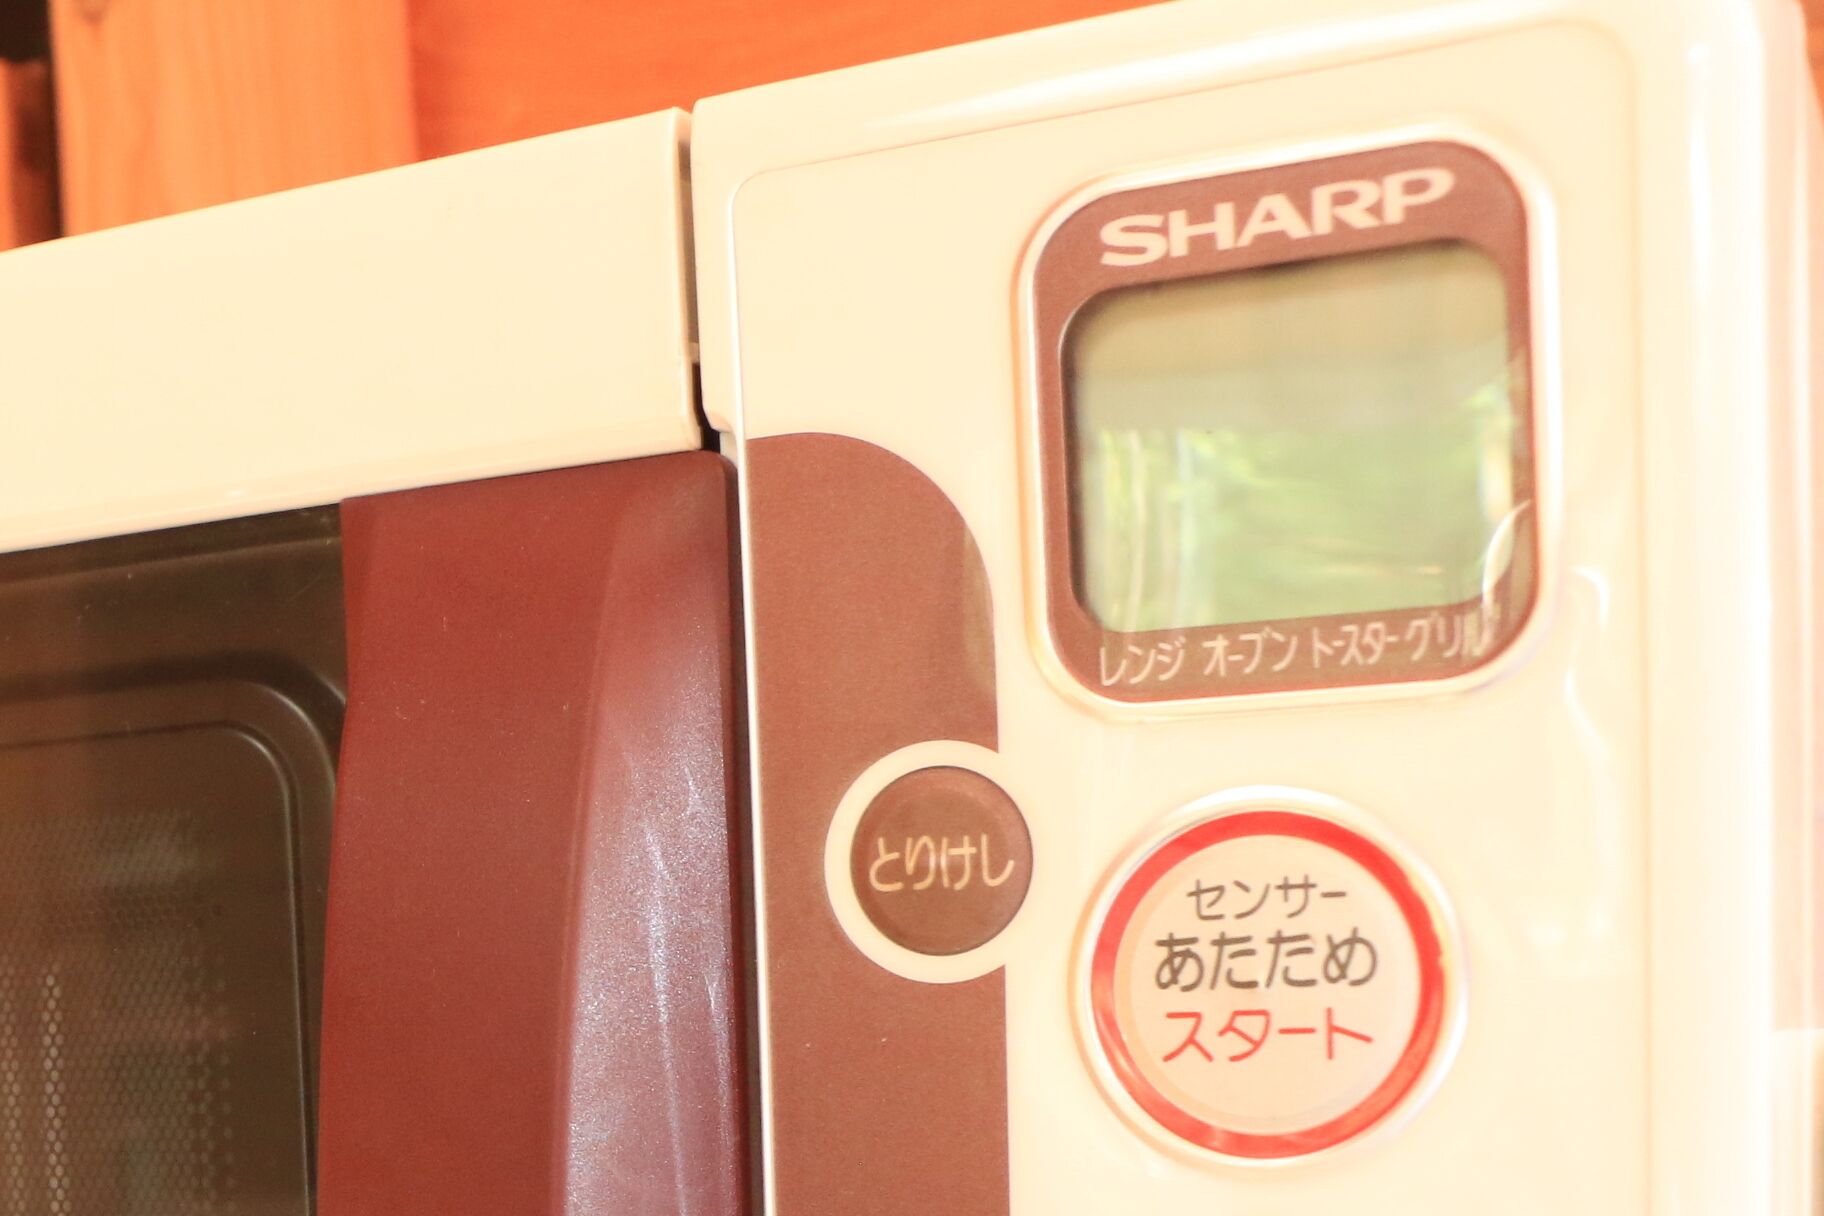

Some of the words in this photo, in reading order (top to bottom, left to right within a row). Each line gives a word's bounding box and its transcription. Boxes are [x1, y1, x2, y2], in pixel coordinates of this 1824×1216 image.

[1099, 167, 1455, 267] SHARP
[1099, 635, 1186, 687] レンジ
[1203, 626, 1298, 677] オーブン
[1312, 621, 1398, 668] トースター
[869, 833, 1015, 892] とりけし
[1186, 874, 1347, 921] センサー
[1154, 926, 1377, 993] あたため
[1162, 1006, 1374, 1063] スタート
